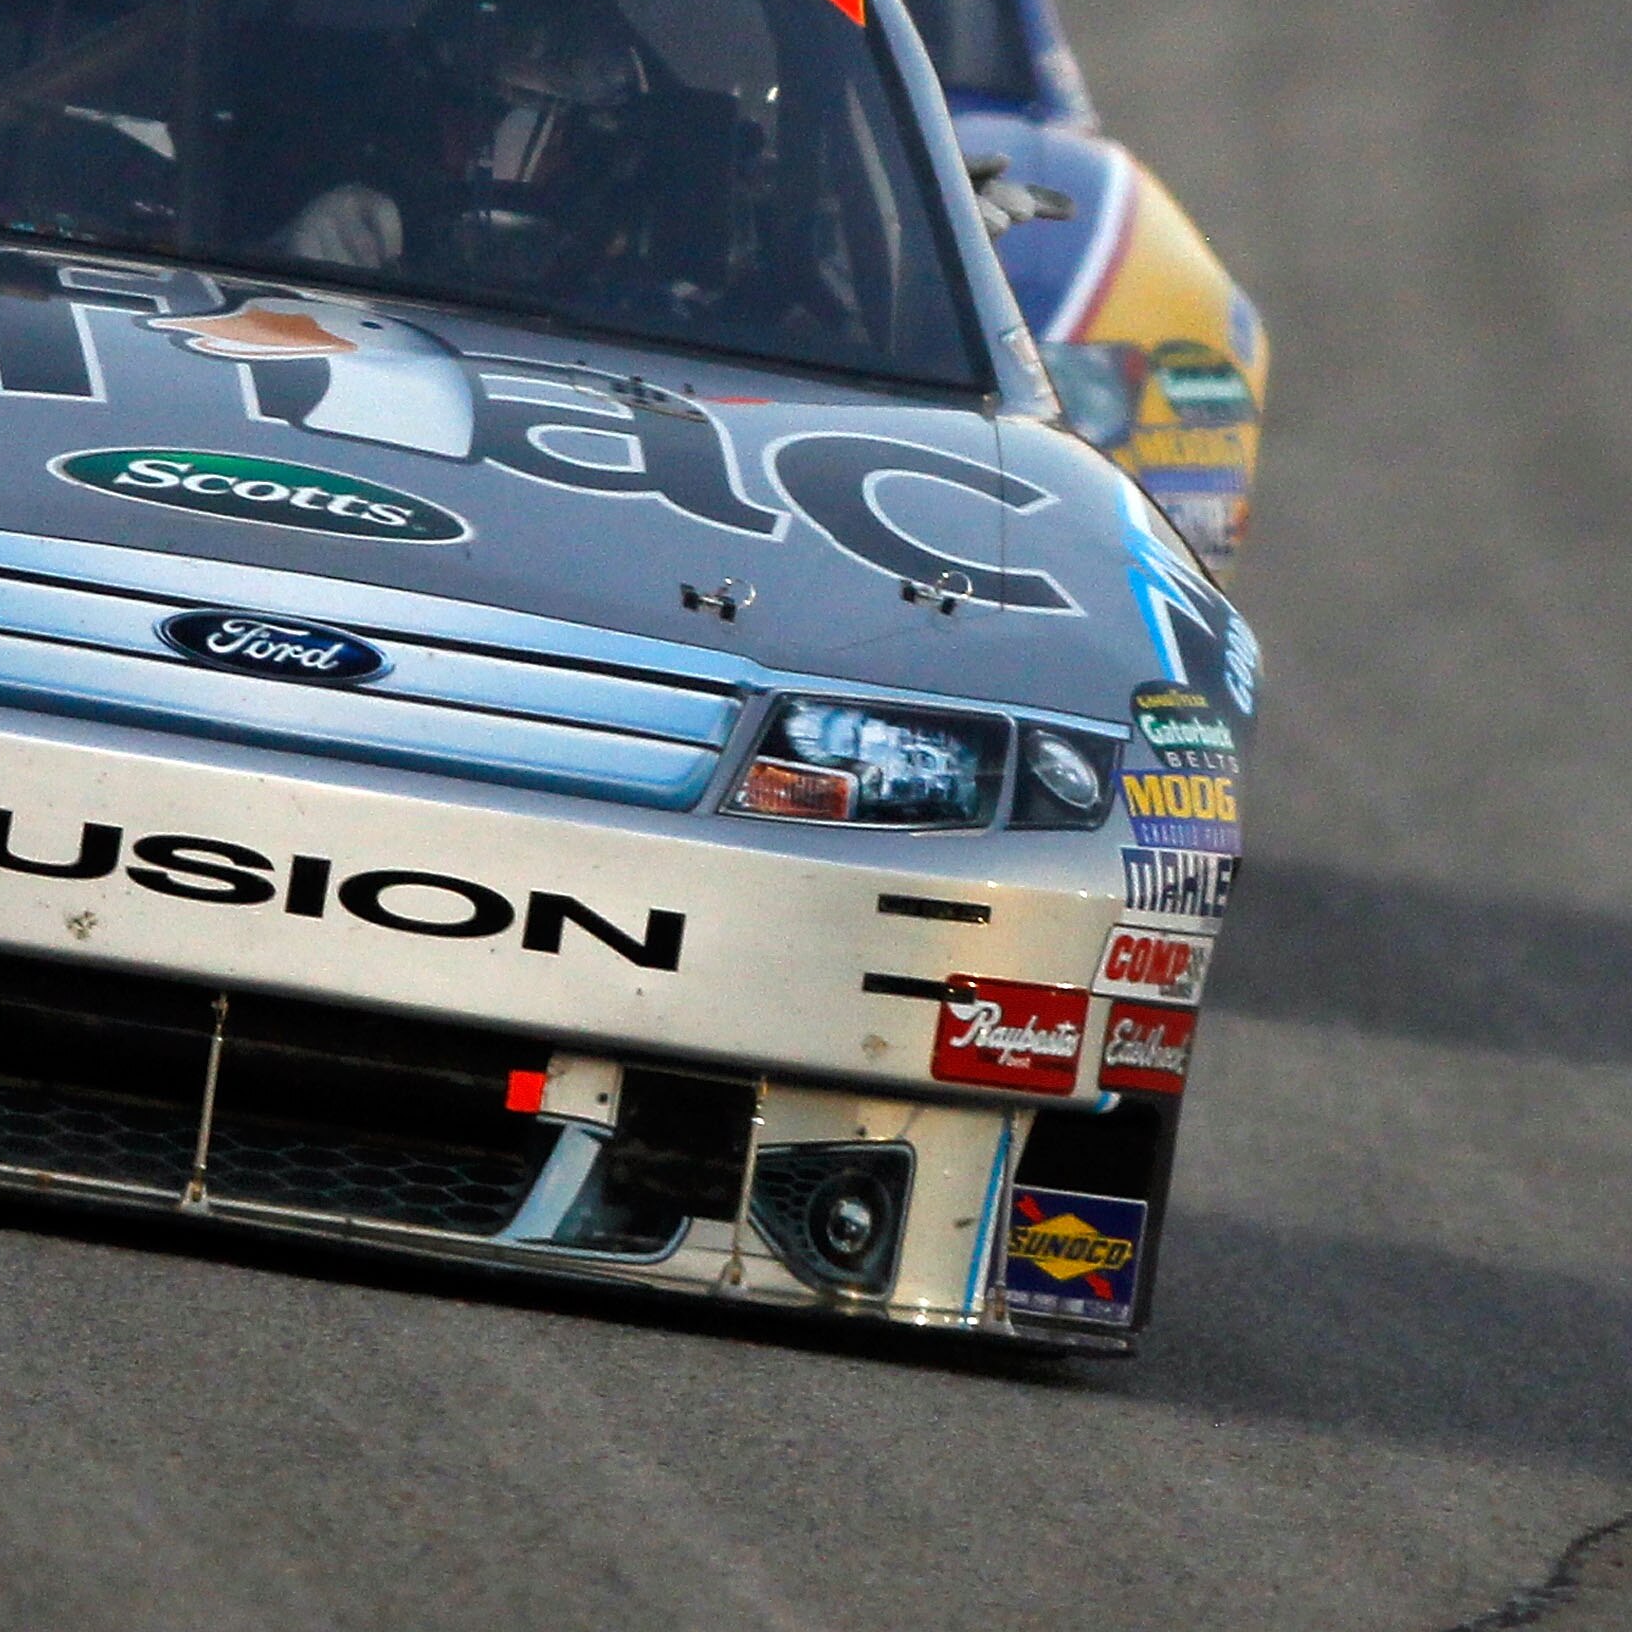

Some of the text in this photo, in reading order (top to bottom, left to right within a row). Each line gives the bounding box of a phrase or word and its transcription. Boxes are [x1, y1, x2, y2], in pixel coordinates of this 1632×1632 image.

[113, 459, 414, 527] Scotts
[206, 616, 344, 671] Ford
[1164, 750, 1239, 773] BELTS
[1122, 774, 1238, 822] MOOG
[1121, 848, 1233, 918] MAHLE
[1106, 934, 1192, 985] COMP
[1009, 1225, 1129, 1265] SUNOCO
